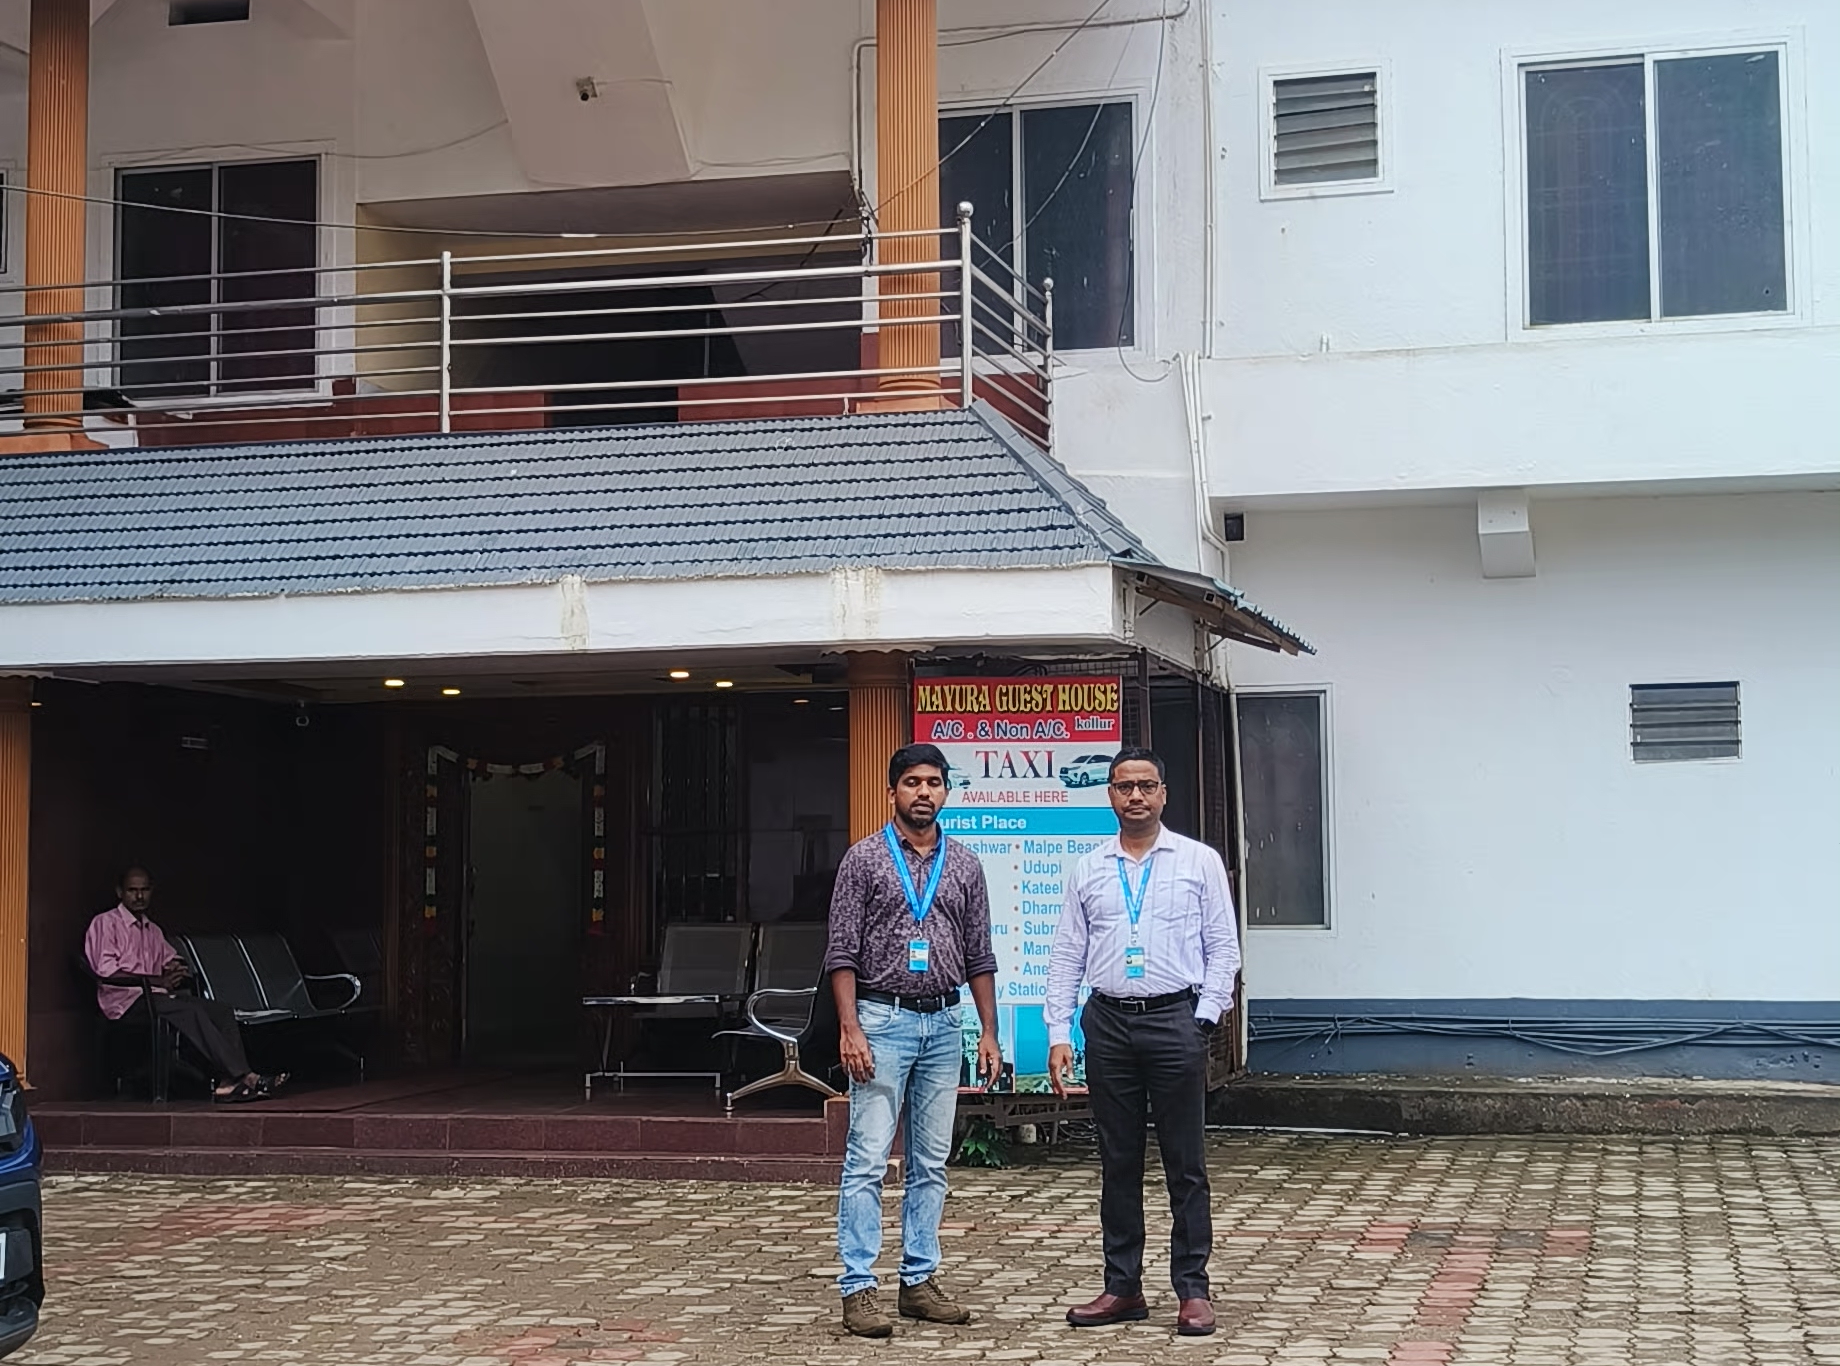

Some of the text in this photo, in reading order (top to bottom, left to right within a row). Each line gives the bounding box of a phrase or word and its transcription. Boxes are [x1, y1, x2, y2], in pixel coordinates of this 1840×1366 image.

[916, 683, 1118, 713] MAYURA GUEST HOUSE
[978, 721, 992, 739] &
[994, 720, 1030, 739] Non
[1033, 720, 1070, 739] A/C.
[1075, 716, 1114, 731] kollur
[975, 750, 1056, 779] TAXI
[962, 791, 1069, 803] AVAILABLE HERE
[940, 814, 1027, 830] urist Place
[961, 839, 1012, 854] eshwar
[1023, 839, 1063, 856] Malpe
[1023, 860, 1062, 877] Udupi
[1022, 880, 1063, 895] Kateel
[1022, 900, 1063, 915] Dharm
[1023, 920, 1055, 935] Subr
[1023, 941, 1051, 955] Man
[1022, 961, 1049, 976] Ane
[1008, 981, 1047, 996] Statio
